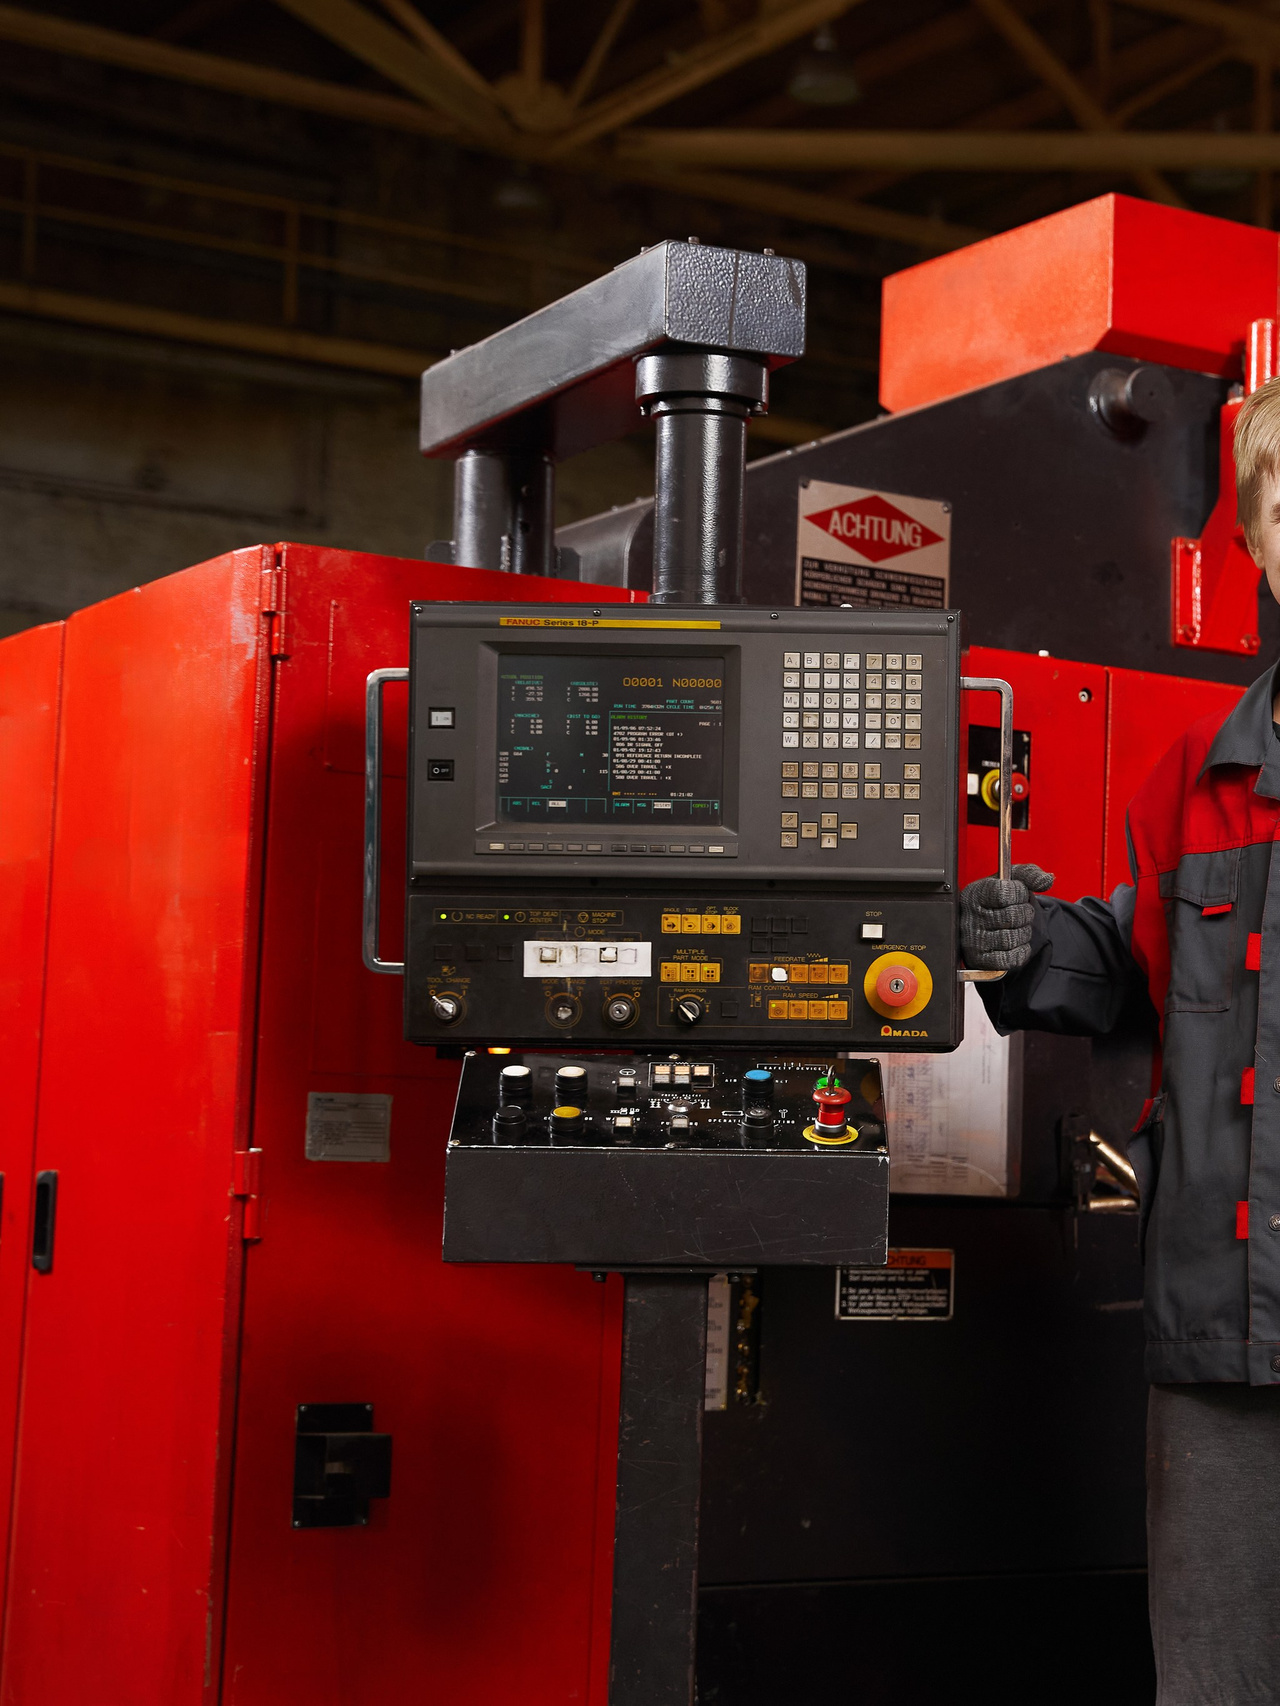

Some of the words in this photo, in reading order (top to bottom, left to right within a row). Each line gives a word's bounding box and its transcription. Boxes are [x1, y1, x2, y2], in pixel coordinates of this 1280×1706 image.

[828, 510, 922, 548] ACHTUNG
[506, 618, 541, 626] FANUC
[543, 619, 574, 627] Series
[577, 619, 599, 627] 18-P
[786, 656, 793, 664] A
[806, 657, 813, 665] B
[825, 657, 832, 665] C
[845, 657, 852, 665] F
[911, 658, 917, 666] 9
[672, 678, 722, 688] N00000
[785, 676, 792, 684] G
[910, 678, 917, 686] 6
[805, 696, 812, 704] N
[880, 1024, 929, 1037] AMADA
